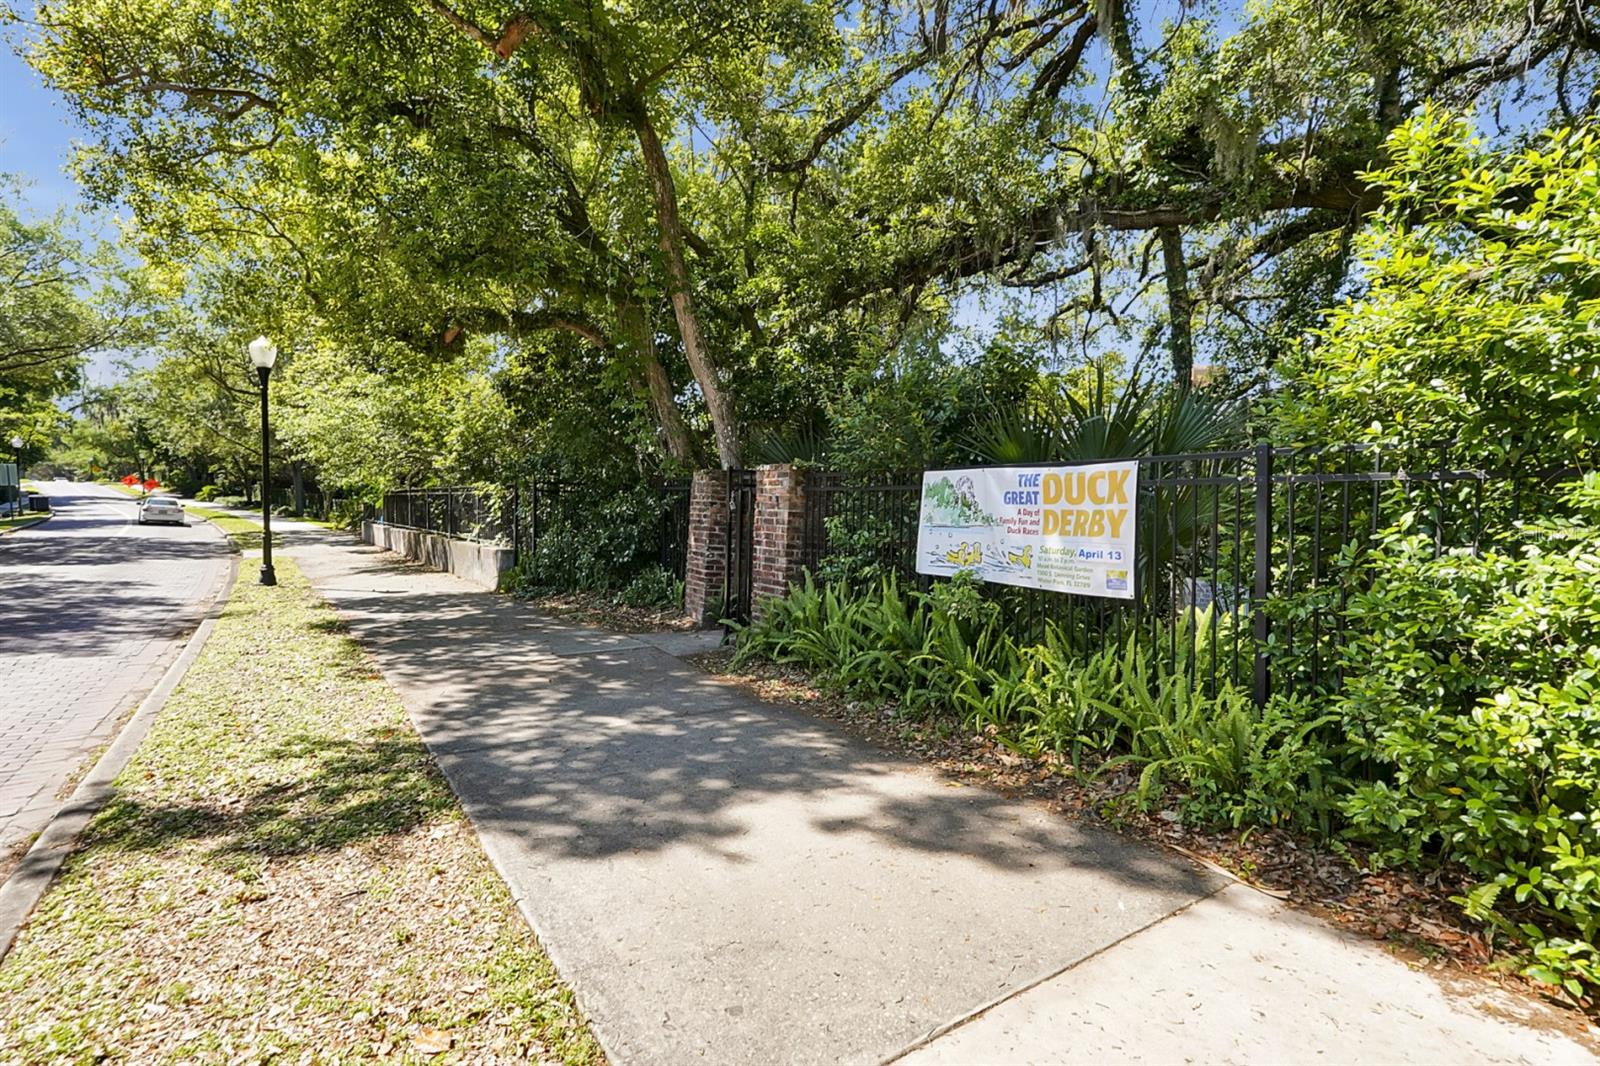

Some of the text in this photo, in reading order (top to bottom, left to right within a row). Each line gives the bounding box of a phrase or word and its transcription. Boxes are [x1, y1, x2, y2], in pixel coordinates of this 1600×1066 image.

[1018, 473, 1040, 487] THE
[1042, 469, 1131, 505] DUCK
[1004, 491, 1040, 505] GREAT
[1023, 508, 1033, 518] Day
[1034, 508, 1040, 516] of
[999, 516, 1017, 526] Family
[1029, 518, 1040, 526] and
[1042, 508, 1128, 538] DERBY
[1007, 526, 1039, 536] Duck Races
[1039, 546, 1122, 560] Saturday, April 13
